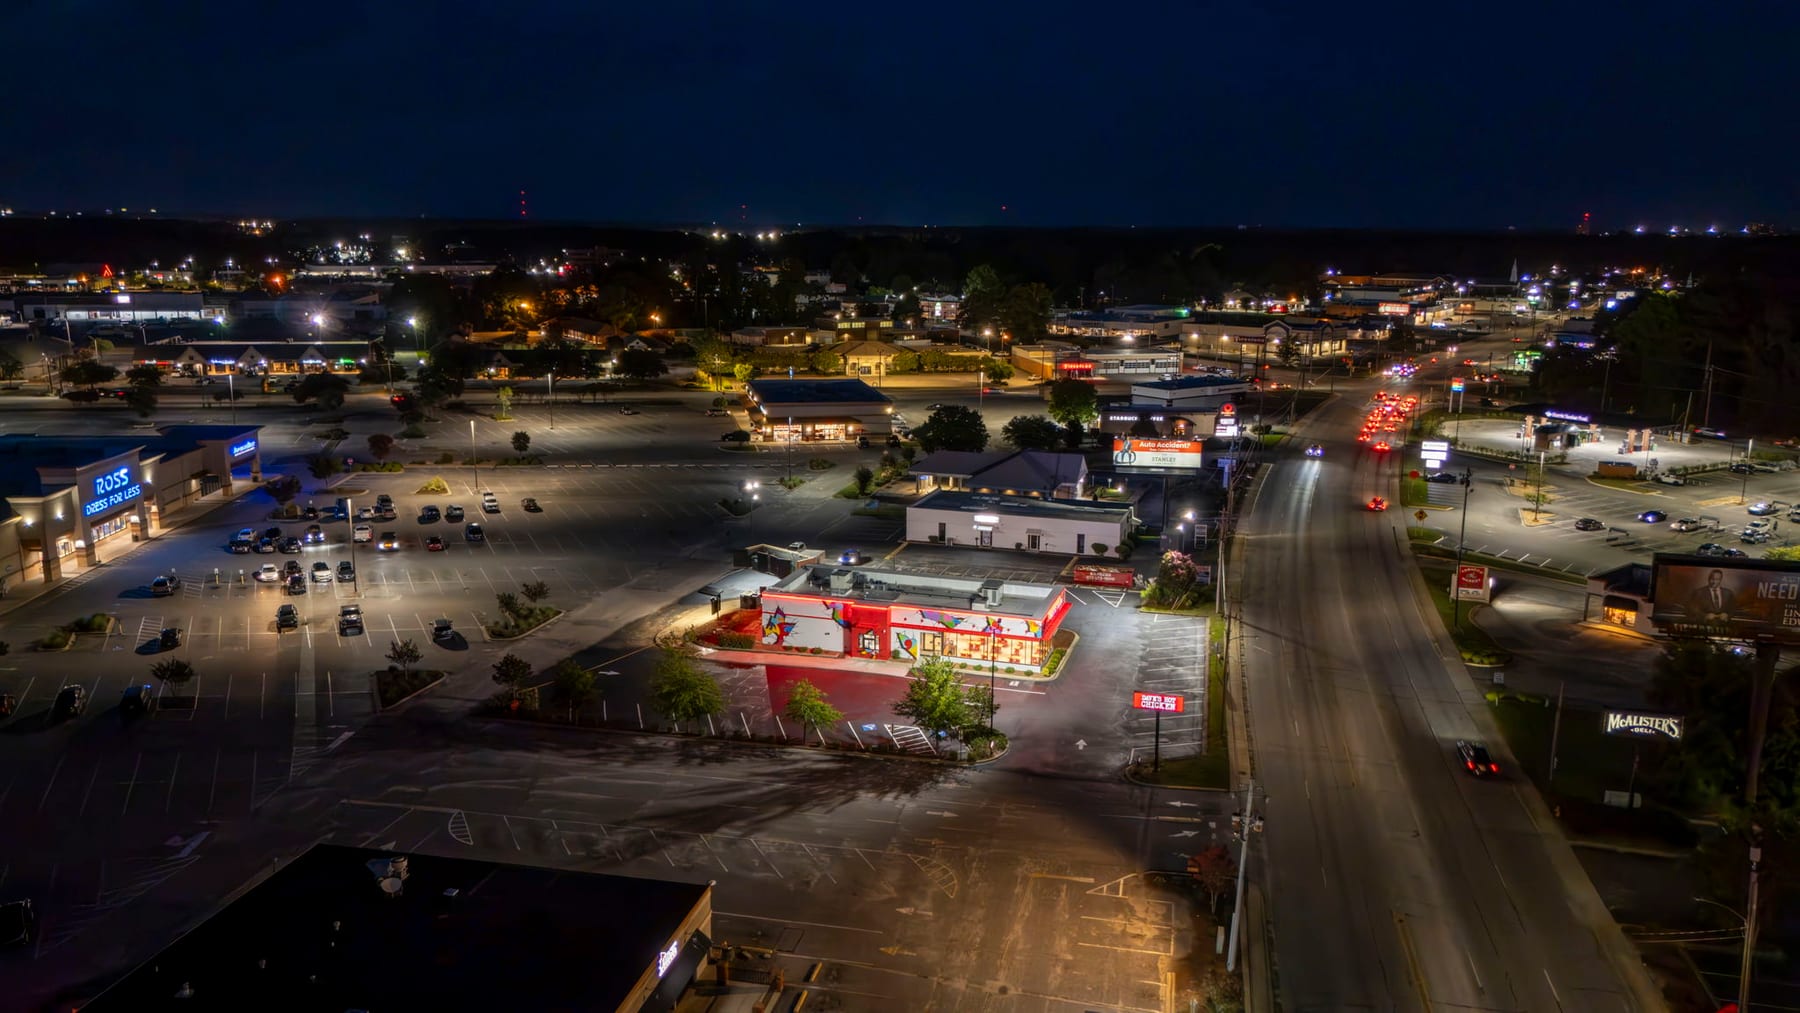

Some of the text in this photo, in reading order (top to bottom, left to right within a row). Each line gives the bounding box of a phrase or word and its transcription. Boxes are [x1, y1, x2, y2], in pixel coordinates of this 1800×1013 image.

[96, 468, 129, 495] ROSS
[85, 485, 141, 516] DRESS FOR LESS
[1757, 582, 1799, 600] NEED
[1141, 701, 1176, 710] CHICKEN
